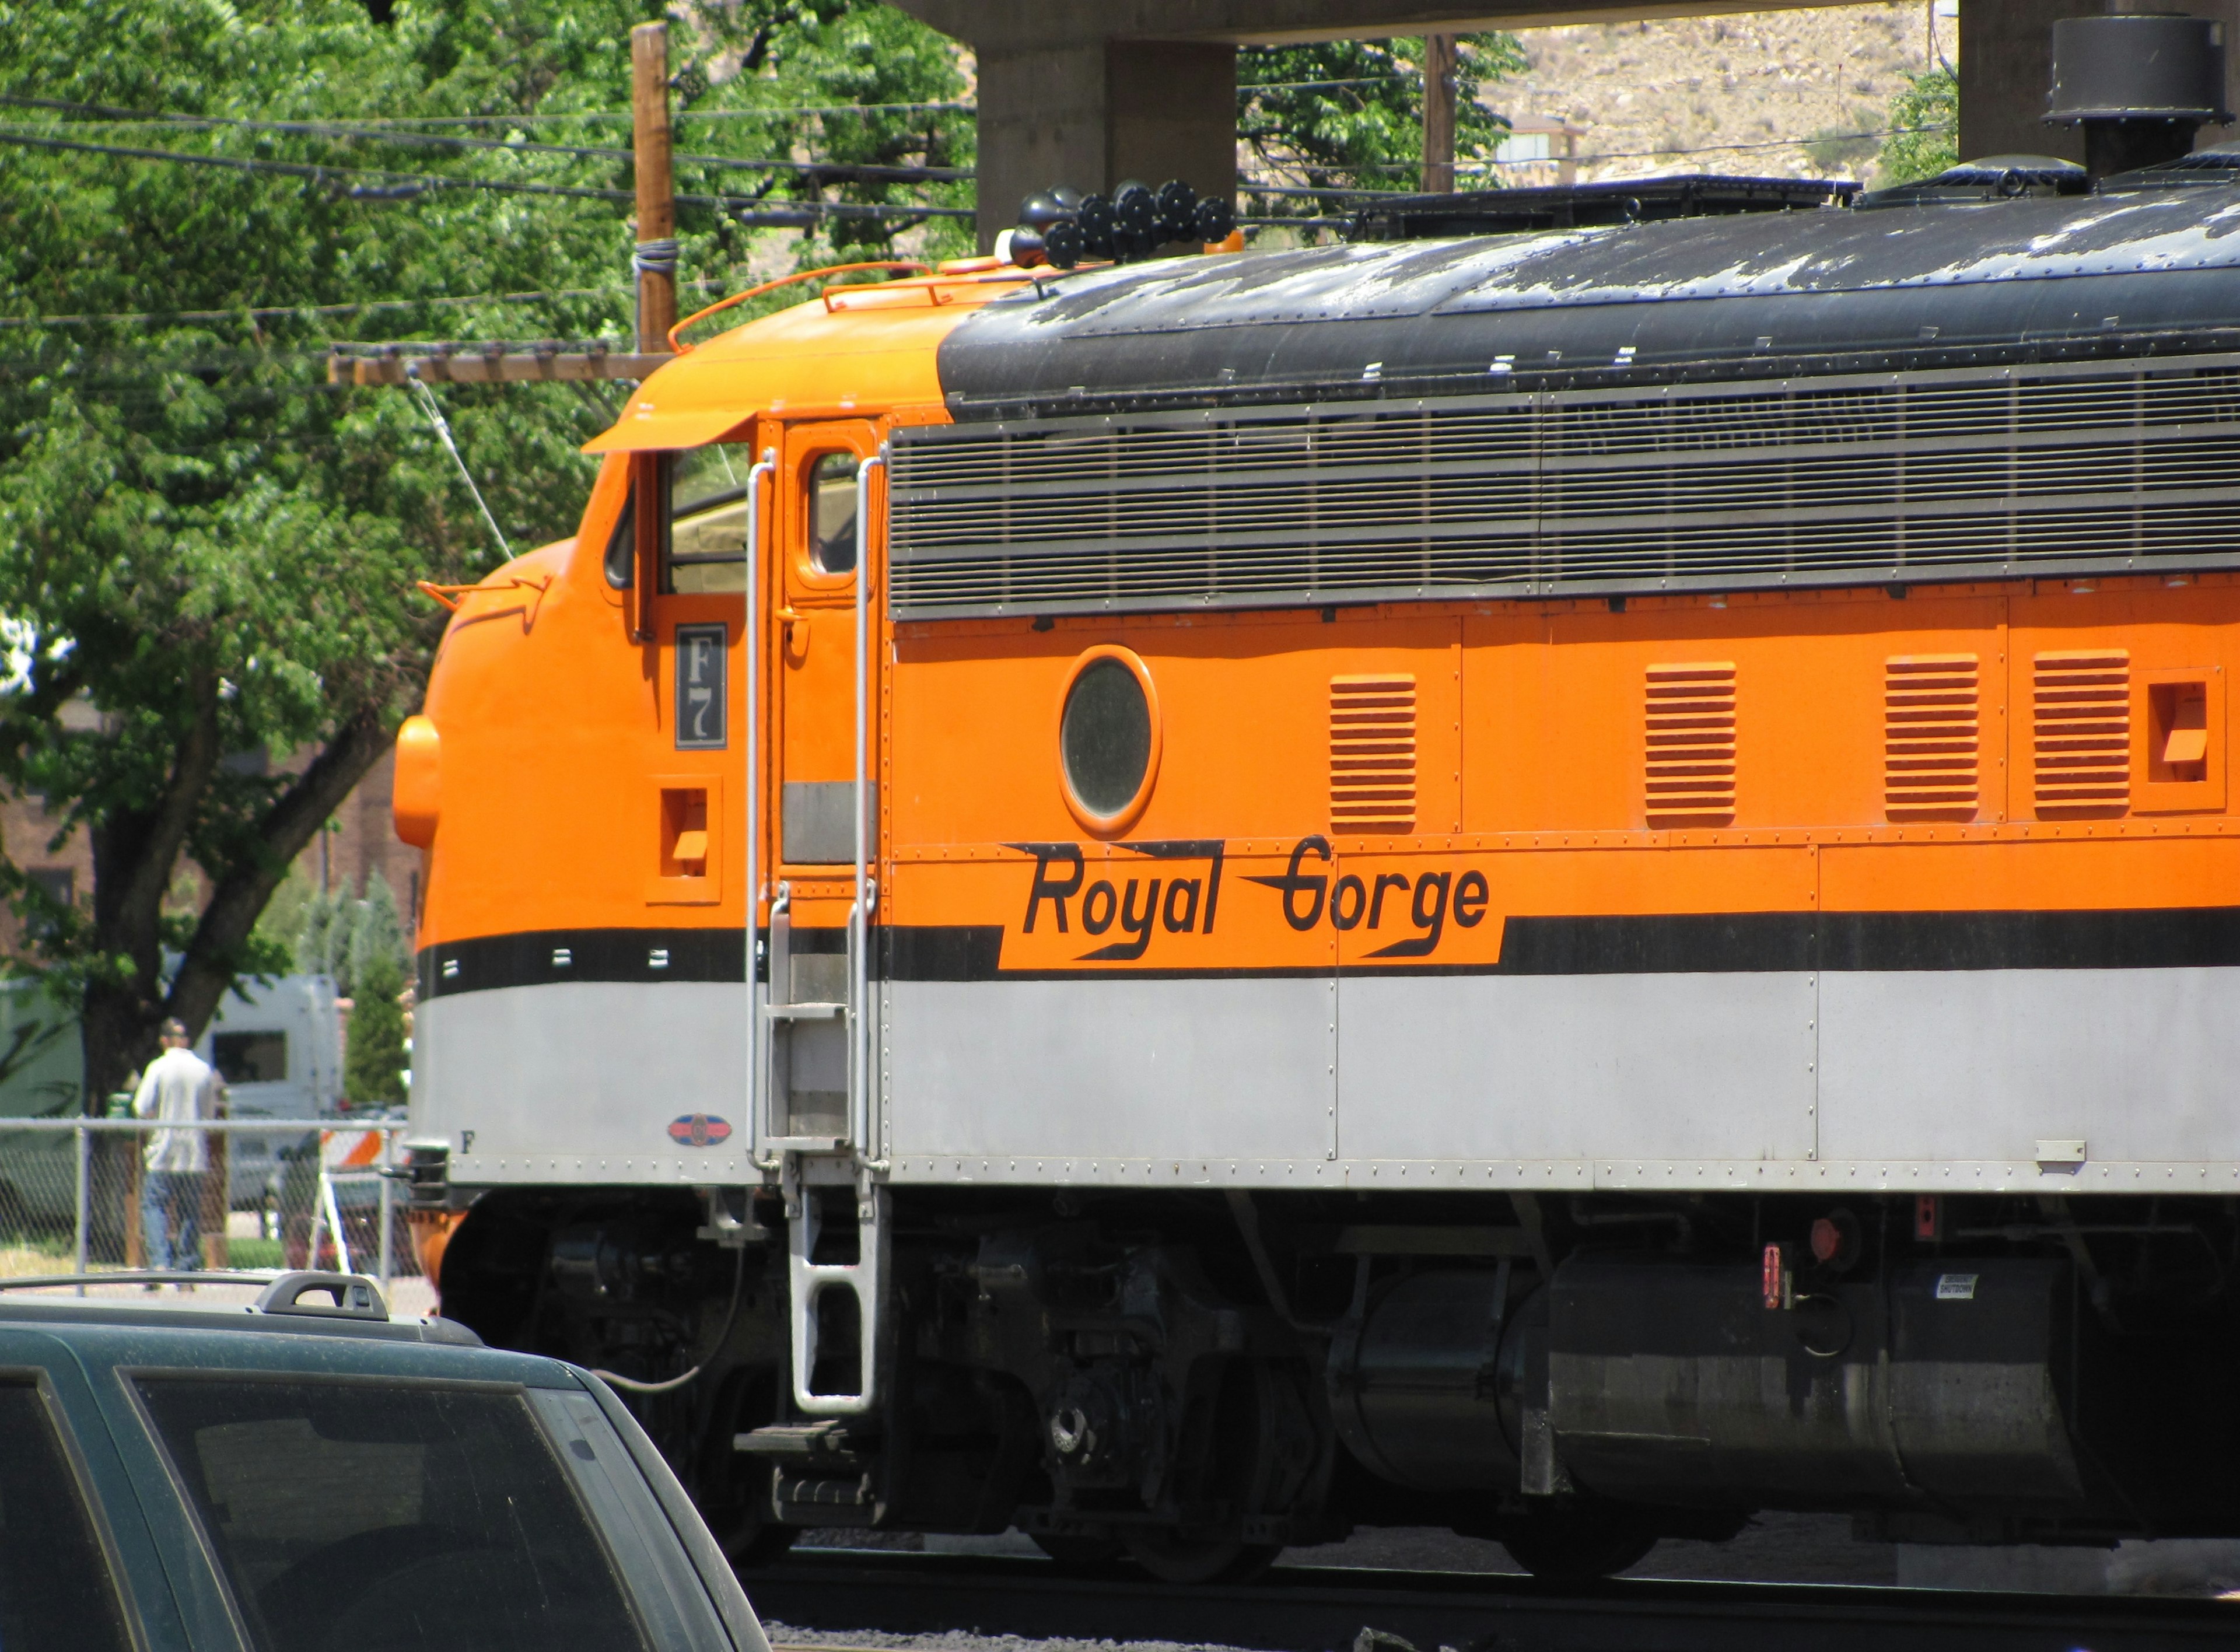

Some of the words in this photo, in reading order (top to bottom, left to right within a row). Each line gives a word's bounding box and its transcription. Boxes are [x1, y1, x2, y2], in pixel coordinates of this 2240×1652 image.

[999, 839, 1226, 961] Royal
[1236, 835, 1489, 958] Gorge
[1940, 1284, 1972, 1293] SHUTDOWN
